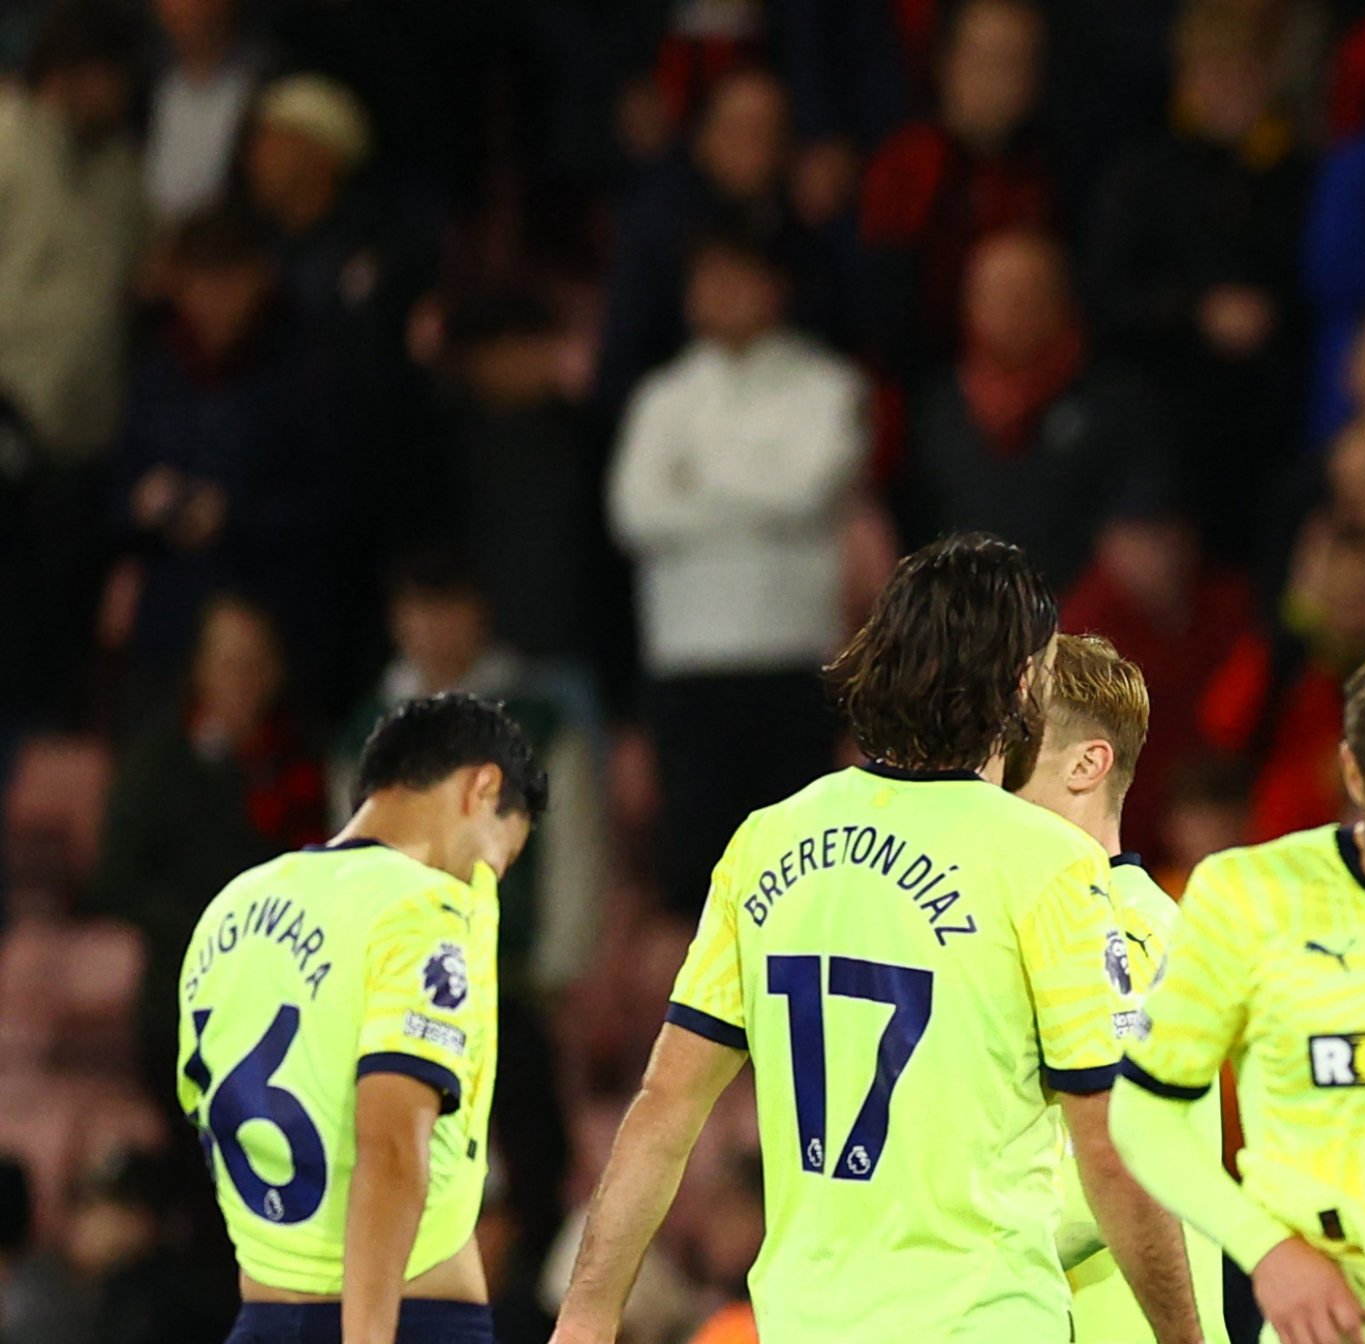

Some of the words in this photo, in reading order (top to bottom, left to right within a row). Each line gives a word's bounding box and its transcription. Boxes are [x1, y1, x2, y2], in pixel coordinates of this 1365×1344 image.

[744, 826, 907, 928] BRERETON
[897, 854, 977, 946] DÍAZ
[766, 955, 934, 1181] 17
